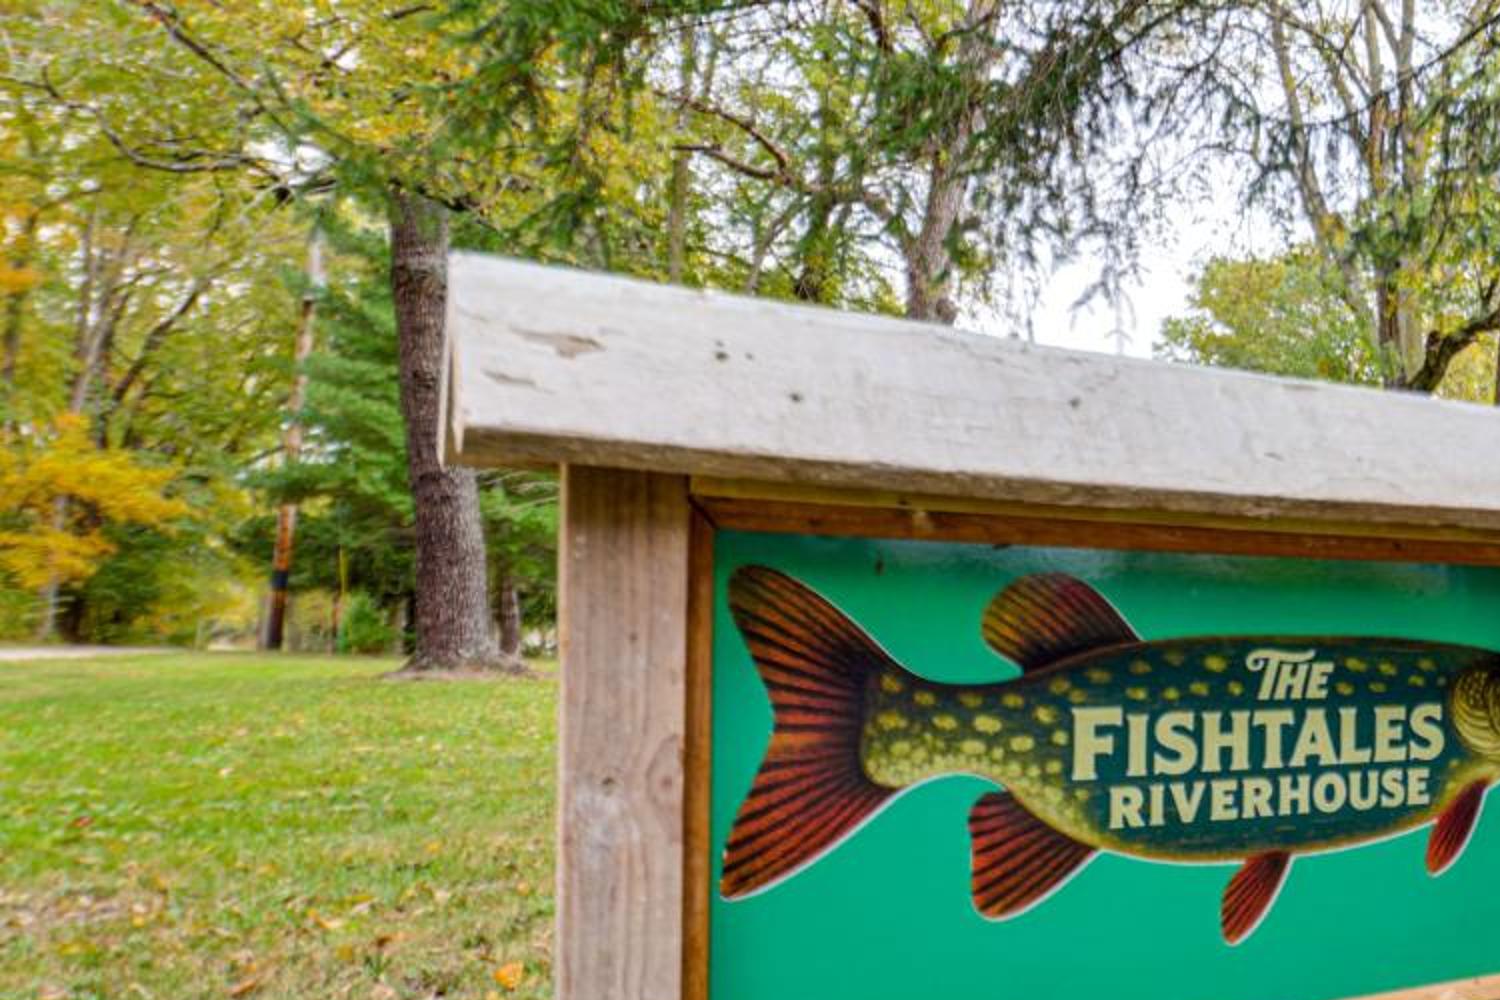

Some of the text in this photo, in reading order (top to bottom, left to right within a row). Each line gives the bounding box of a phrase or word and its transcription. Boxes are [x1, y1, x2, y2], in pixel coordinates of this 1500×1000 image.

[1245, 648, 1335, 700] THE
[1071, 702, 1446, 782] FISHTALES
[1109, 767, 1431, 830] RIVERHOUSE
